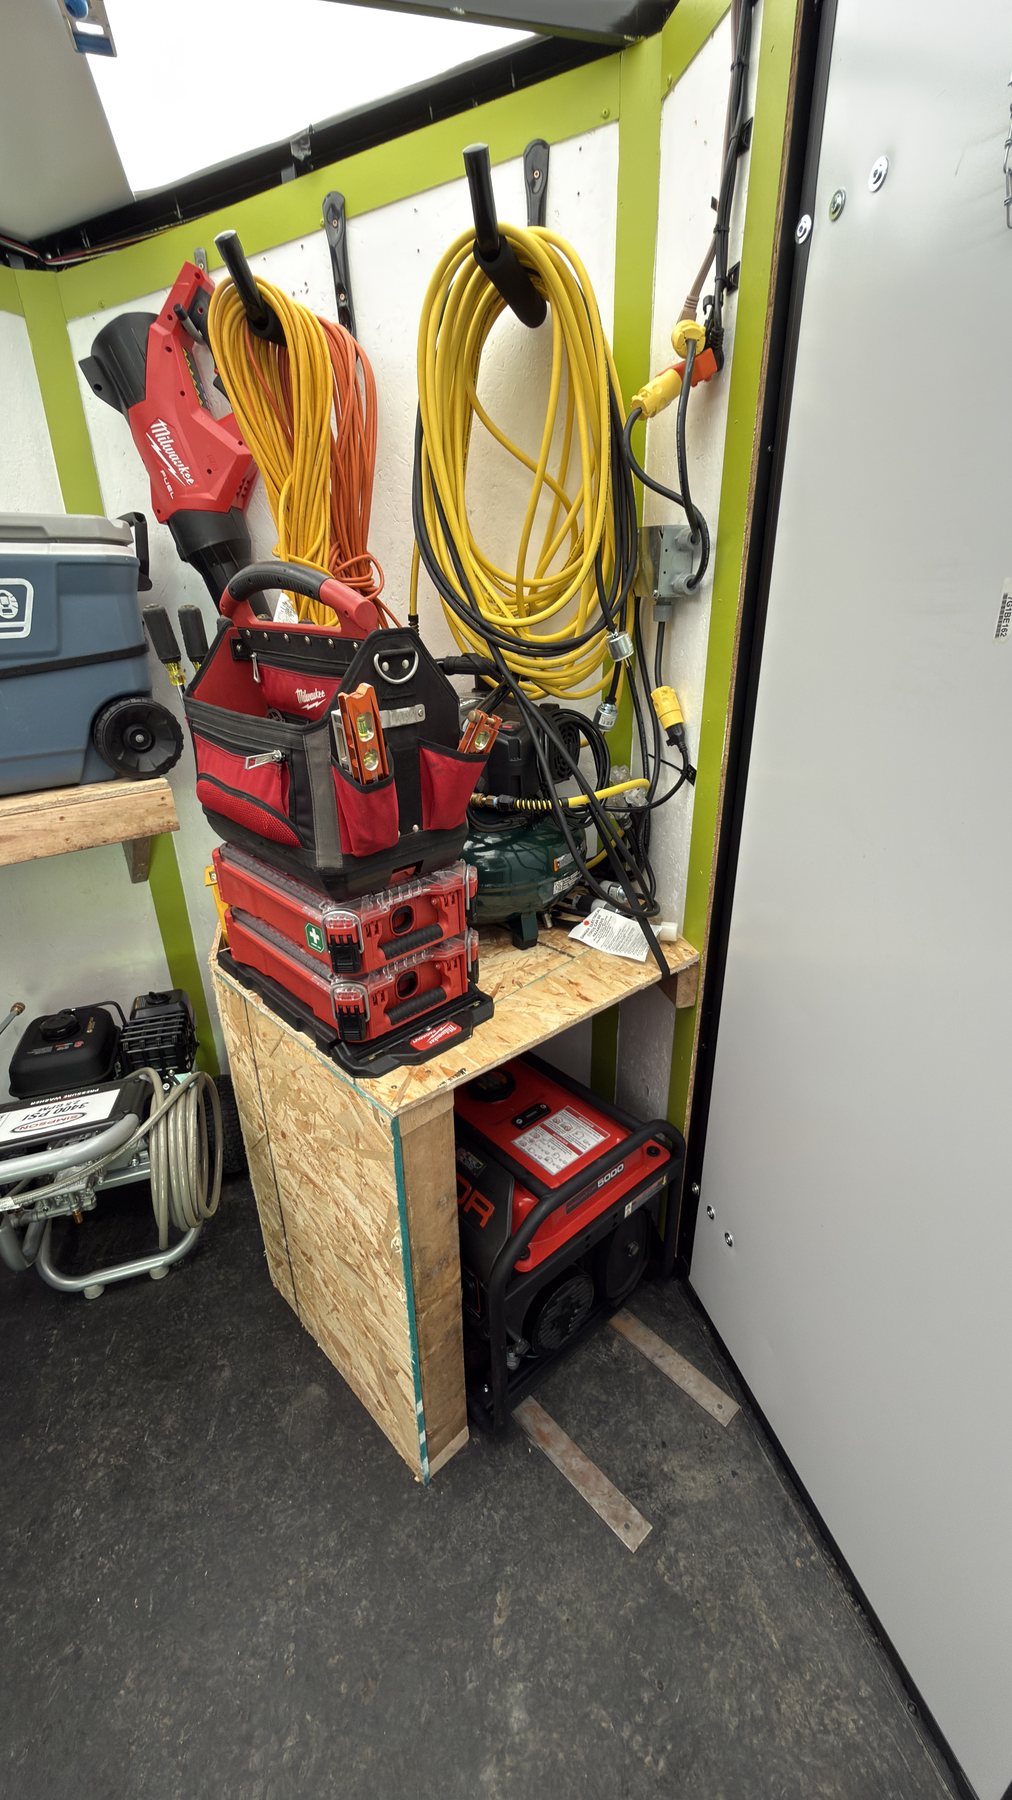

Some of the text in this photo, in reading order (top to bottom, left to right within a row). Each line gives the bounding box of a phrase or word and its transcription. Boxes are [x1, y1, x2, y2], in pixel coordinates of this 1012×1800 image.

[150, 418, 195, 486] Milwaukee
[160, 470, 175, 500] FUEL
[295, 688, 326, 703] Milwaukee
[30, 1088, 100, 1106] PRESSURE WASHER
[22, 1101, 89, 1121] 3400 PSI
[19, 1115, 79, 1131] SIMPSON
[597, 1163, 624, 1188] 5000
